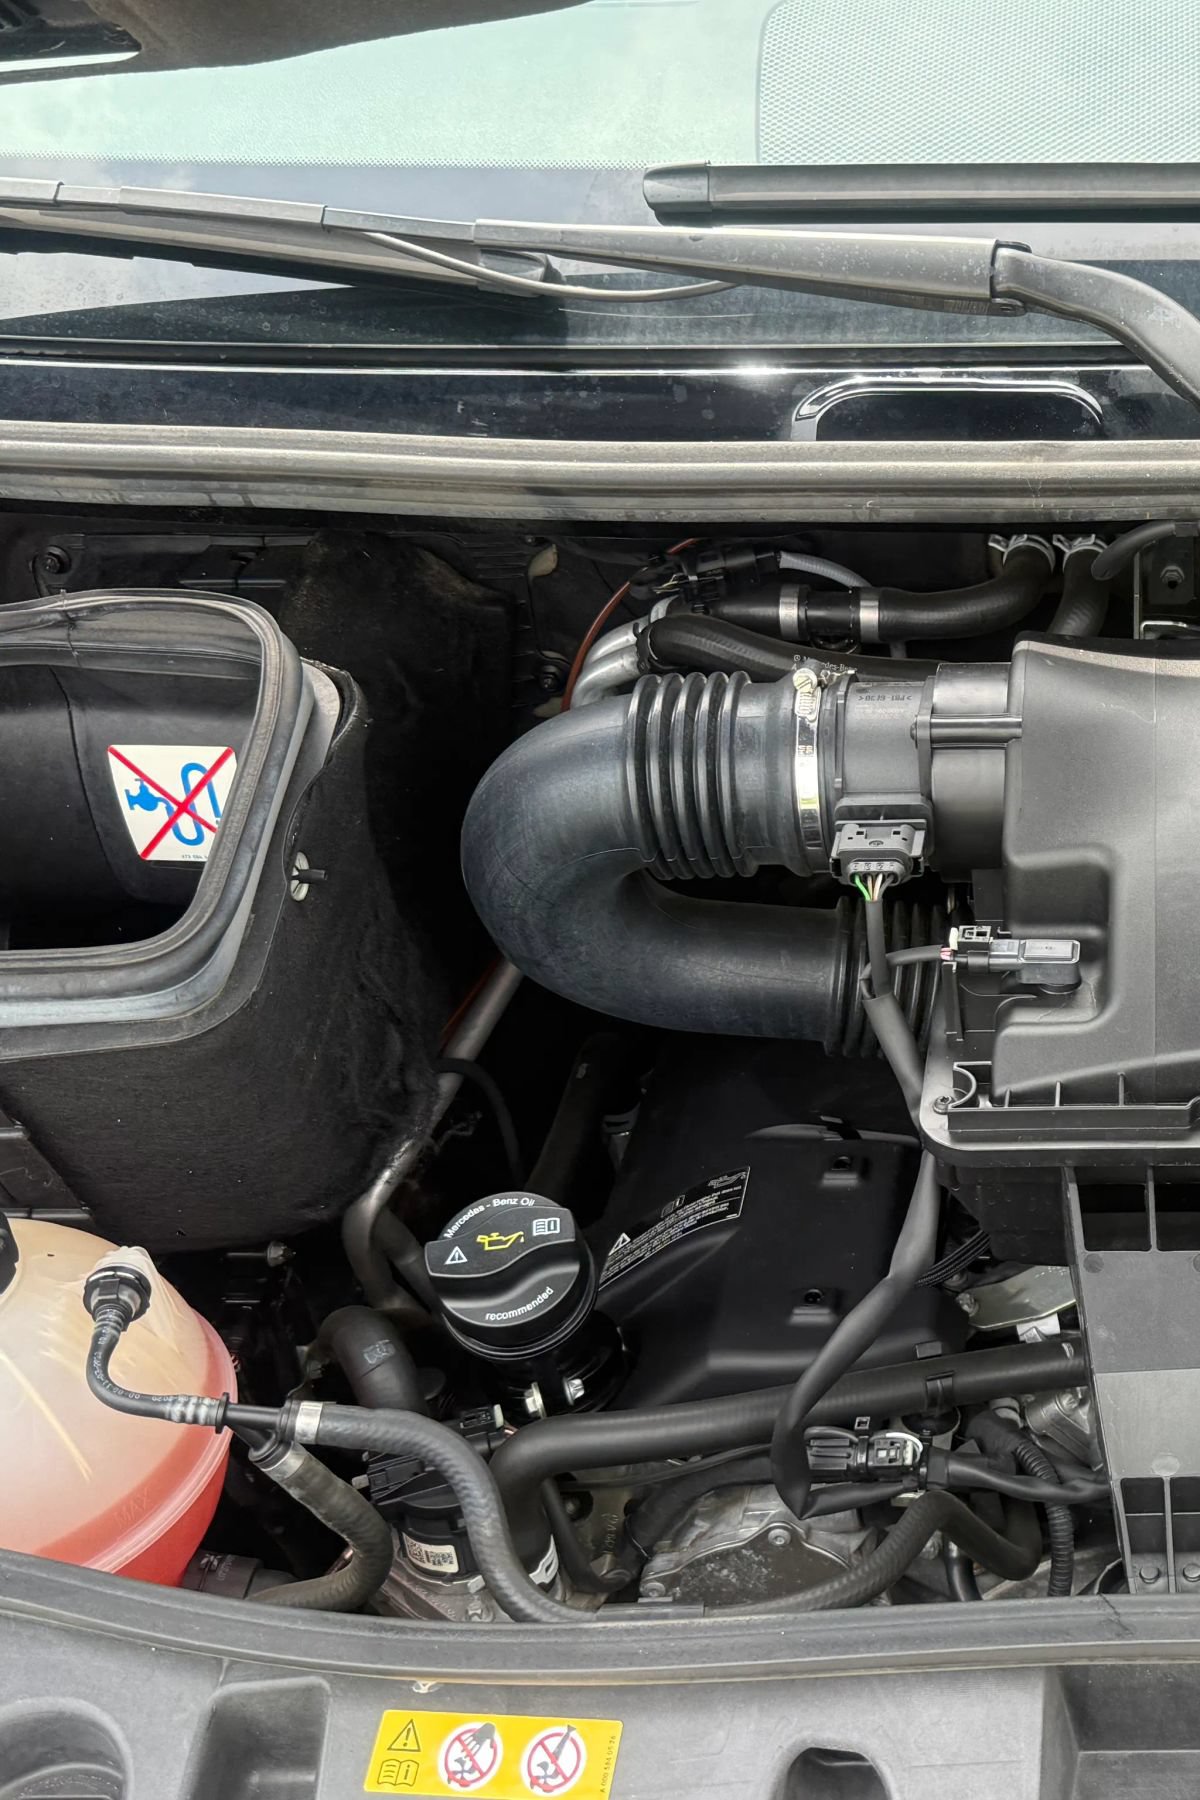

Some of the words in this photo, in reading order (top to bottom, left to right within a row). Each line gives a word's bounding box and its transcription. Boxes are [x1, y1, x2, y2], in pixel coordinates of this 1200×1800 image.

[443, 1205, 485, 1238] Mercedes
[492, 1198, 518, 1207] Benz
[520, 1197, 536, 1207] Oil
[485, 1286, 554, 1321] recommended
